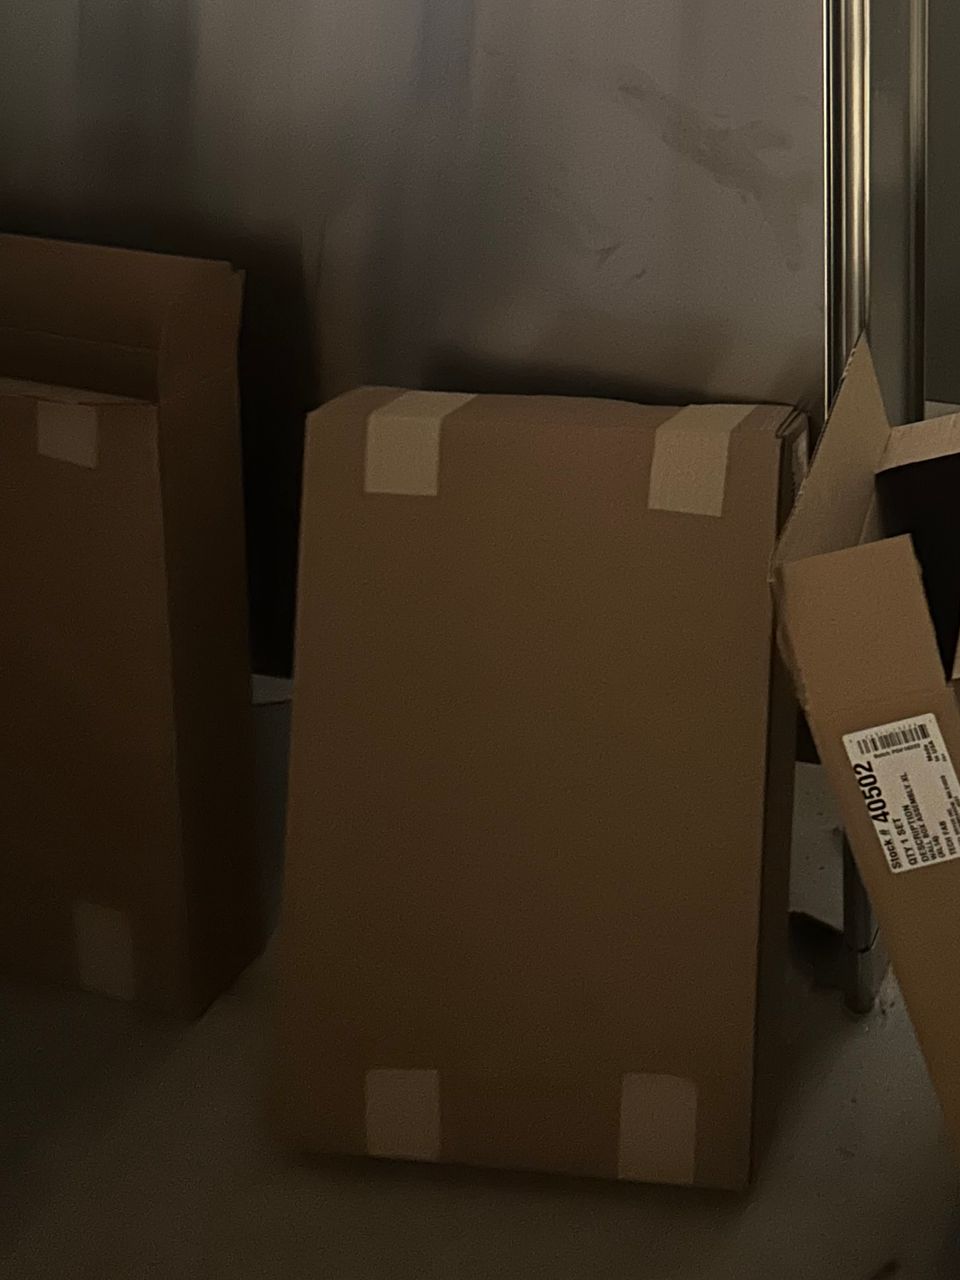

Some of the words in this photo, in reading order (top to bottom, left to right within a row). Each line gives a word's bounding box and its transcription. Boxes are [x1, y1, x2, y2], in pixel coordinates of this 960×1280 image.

[900, 772, 909, 783] XL
[852, 761, 889, 823] 40502
[904, 784, 924, 822] ASSEMBLY
[892, 818, 907, 836] SET
[902, 804, 930, 863] DESCRIPTION
[919, 823, 930, 839] BOX
[884, 838, 903, 870] Stock
[903, 846, 918, 866] QTY
[925, 840, 937, 861] WALL
